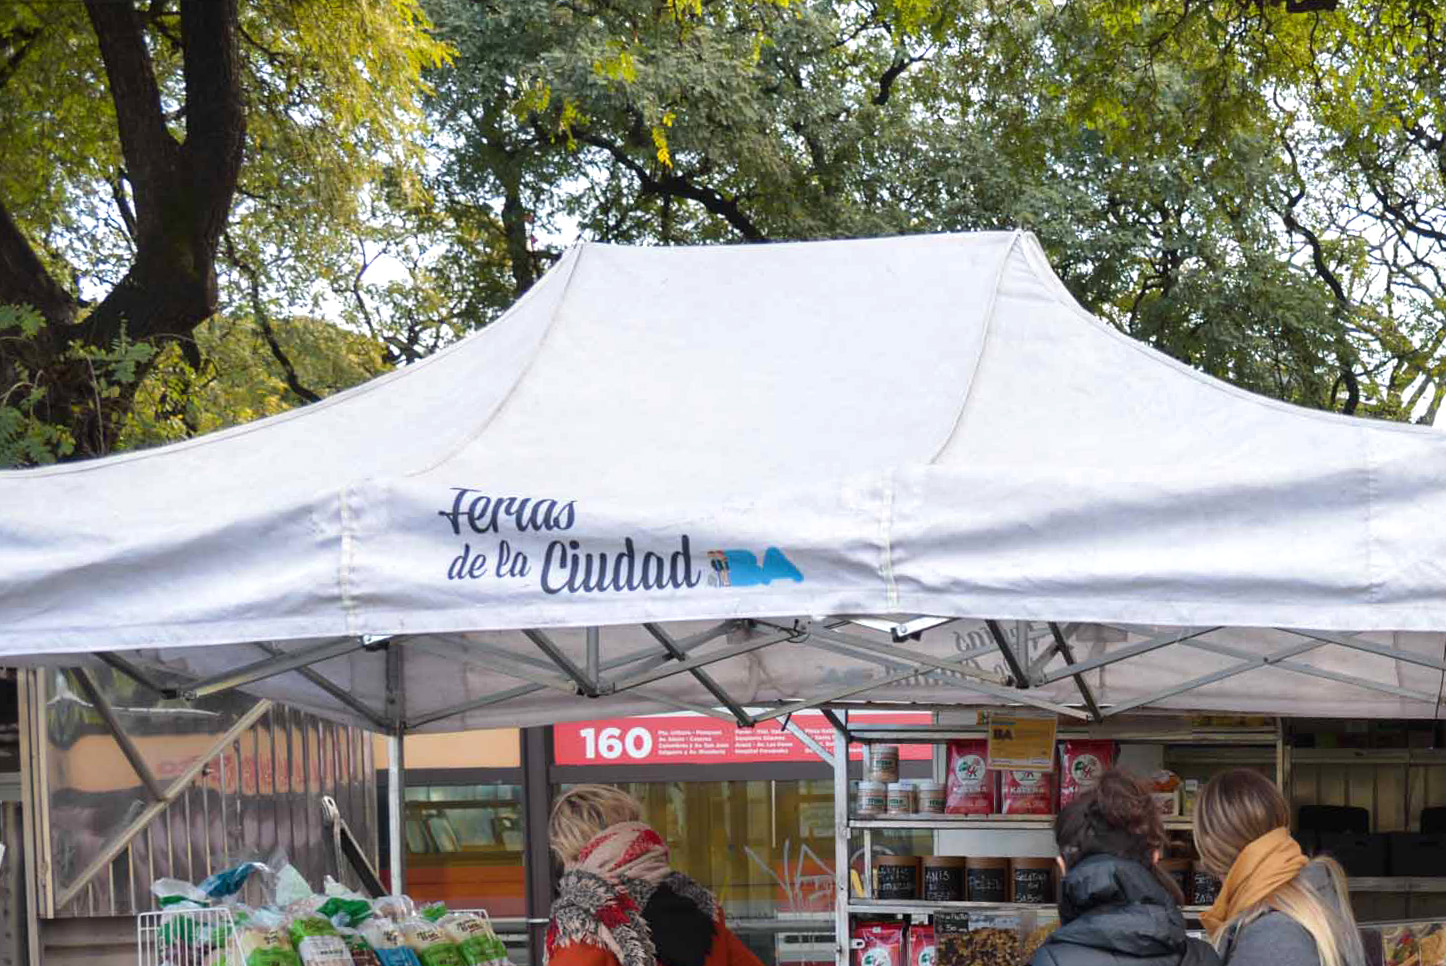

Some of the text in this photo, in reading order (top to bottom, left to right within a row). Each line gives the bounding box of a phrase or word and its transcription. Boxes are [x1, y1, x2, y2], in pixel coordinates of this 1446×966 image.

[439, 488, 578, 535] Ferias
[448, 534, 701, 594] de la Ciudad
[579, 726, 653, 759] 160
